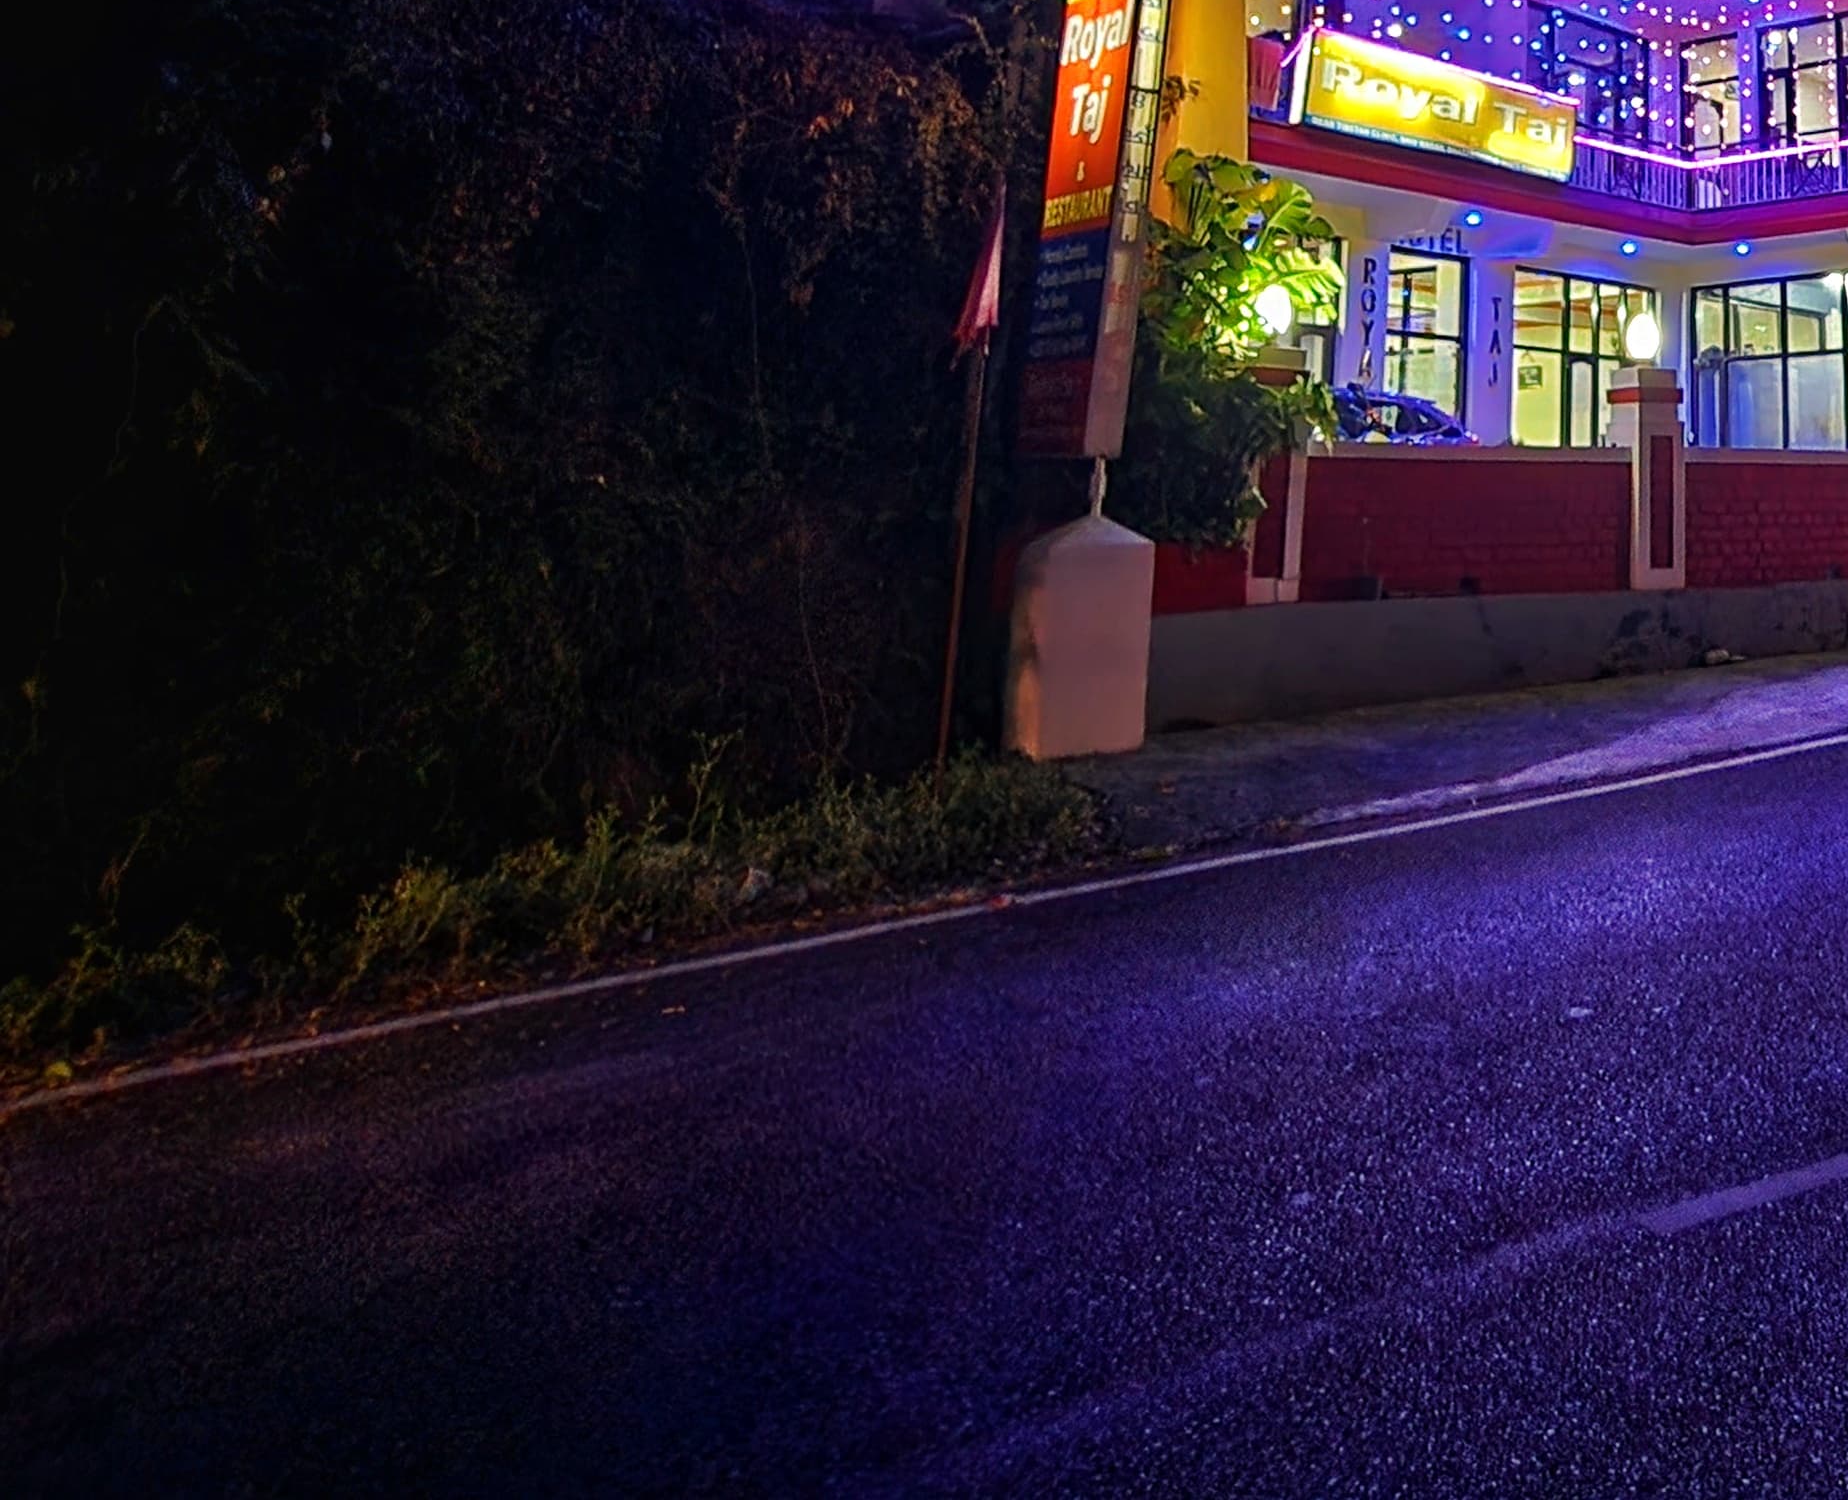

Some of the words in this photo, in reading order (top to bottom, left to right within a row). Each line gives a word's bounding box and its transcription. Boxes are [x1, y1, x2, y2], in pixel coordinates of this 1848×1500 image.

[1070, 74, 1112, 144] Taj
[1321, 57, 1481, 125] Royal
[1493, 101, 1569, 153] Taj
[1044, 185, 1113, 228] RESTAURANT
[1488, 297, 1502, 387] TAJ
